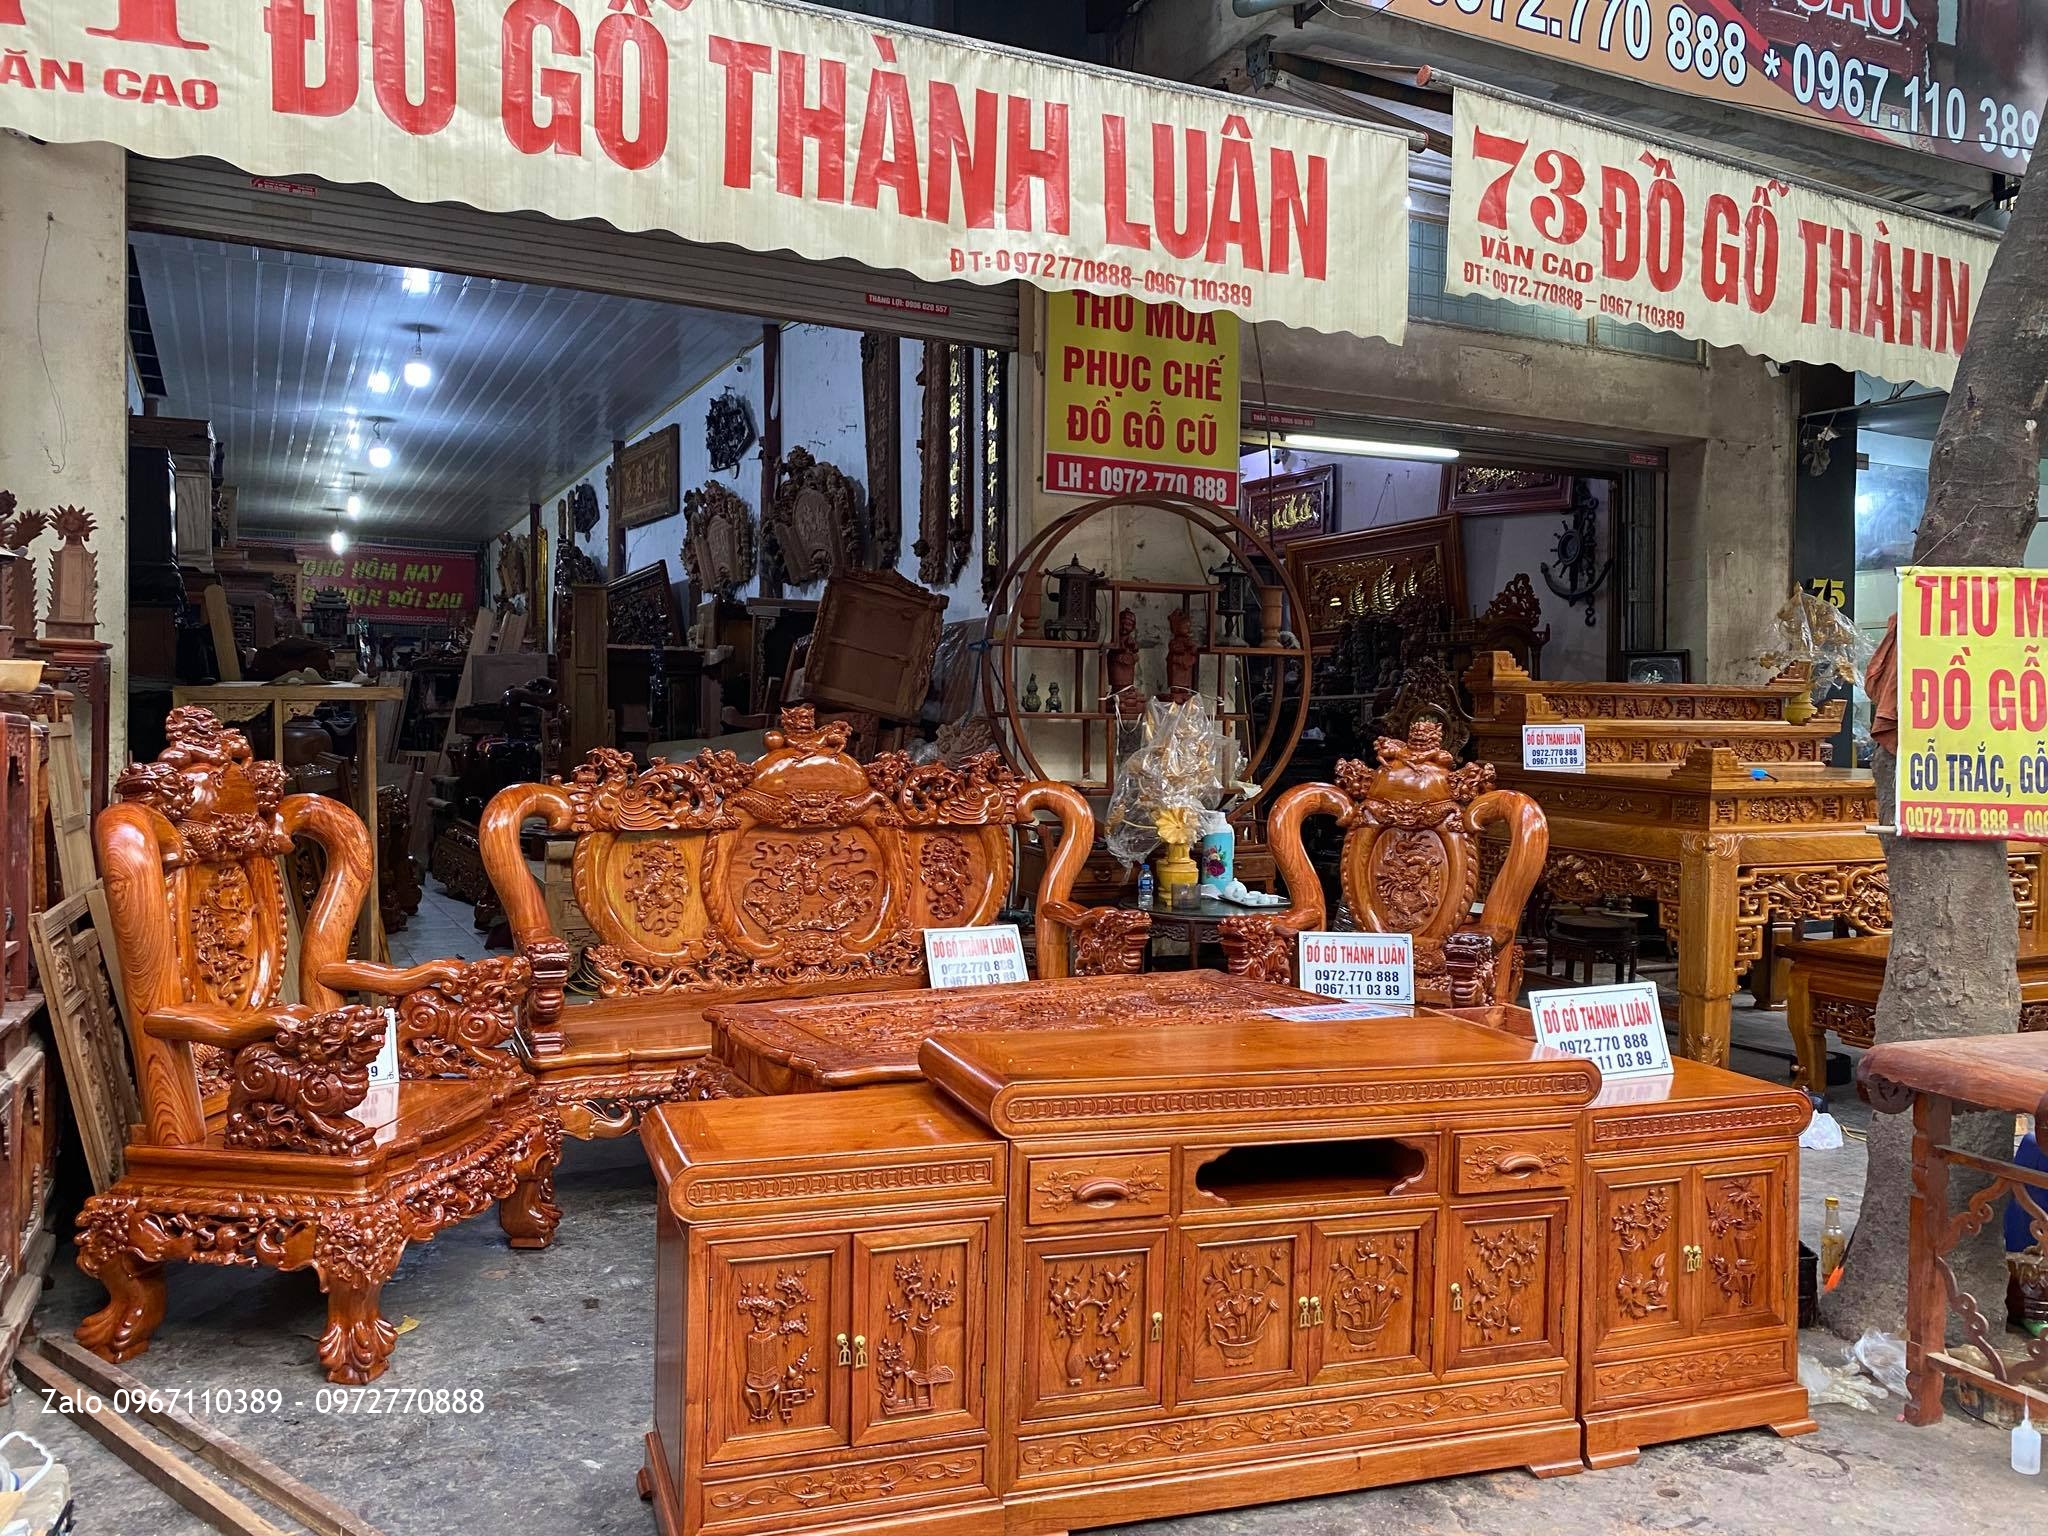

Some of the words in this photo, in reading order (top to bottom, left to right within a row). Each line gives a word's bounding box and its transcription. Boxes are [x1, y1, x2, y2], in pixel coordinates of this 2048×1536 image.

[103, 68, 219, 110] CAO
[1666, 4, 1747, 86] 888
[1792, 42, 1966, 144] 0967.110
[709, 34, 1070, 237] THÀNH
[1102, 114, 1327, 281] LUÂN
[1472, 124, 1588, 245] 73
[1599, 149, 1685, 293] ĐỒ
[1701, 179, 1790, 314] GỖ
[1480, 235, 1535, 270] VĂN
[1541, 252, 1594, 284] CAO
[1145, 302, 1217, 346] MUA
[1064, 346, 1151, 397] PHỤC
[1163, 355, 1226, 402] CHẾ
[1067, 396, 1112, 444] ĐỒ
[1123, 400, 1165, 451] GỖ
[1176, 414, 1217, 456] CŨ
[1193, 475, 1227, 503] 888
[1812, 577, 1846, 609] 75
[1914, 575, 1999, 638] THU
[1910, 646, 1972, 731] ĐỒ
[1988, 644, 2048, 732] GỖ
[1910, 738, 1939, 792] GỖ
[1945, 741, 2012, 798] TRẮC,
[2019, 740, 2048, 794] GỖ
[1315, 969, 1372, 982] 0972.770
[1376, 971, 1399, 982] 888
[1378, 943, 1405, 965] LUÂN
[1315, 983, 1361, 995] 0967.11
[1367, 984, 1381, 995] 03
[1385, 984, 1400, 996] 89
[1543, 1001, 1560, 1034] ĐỒ
[1562, 999, 1579, 1032] GỖ
[1580, 1002, 1619, 1030] THÀNH
[1620, 997, 1652, 1027] LUÂN
[1617, 1053, 1633, 1068] 03
[1636, 1050, 1652, 1065] 89
[1624, 1033, 1648, 1049] 888
